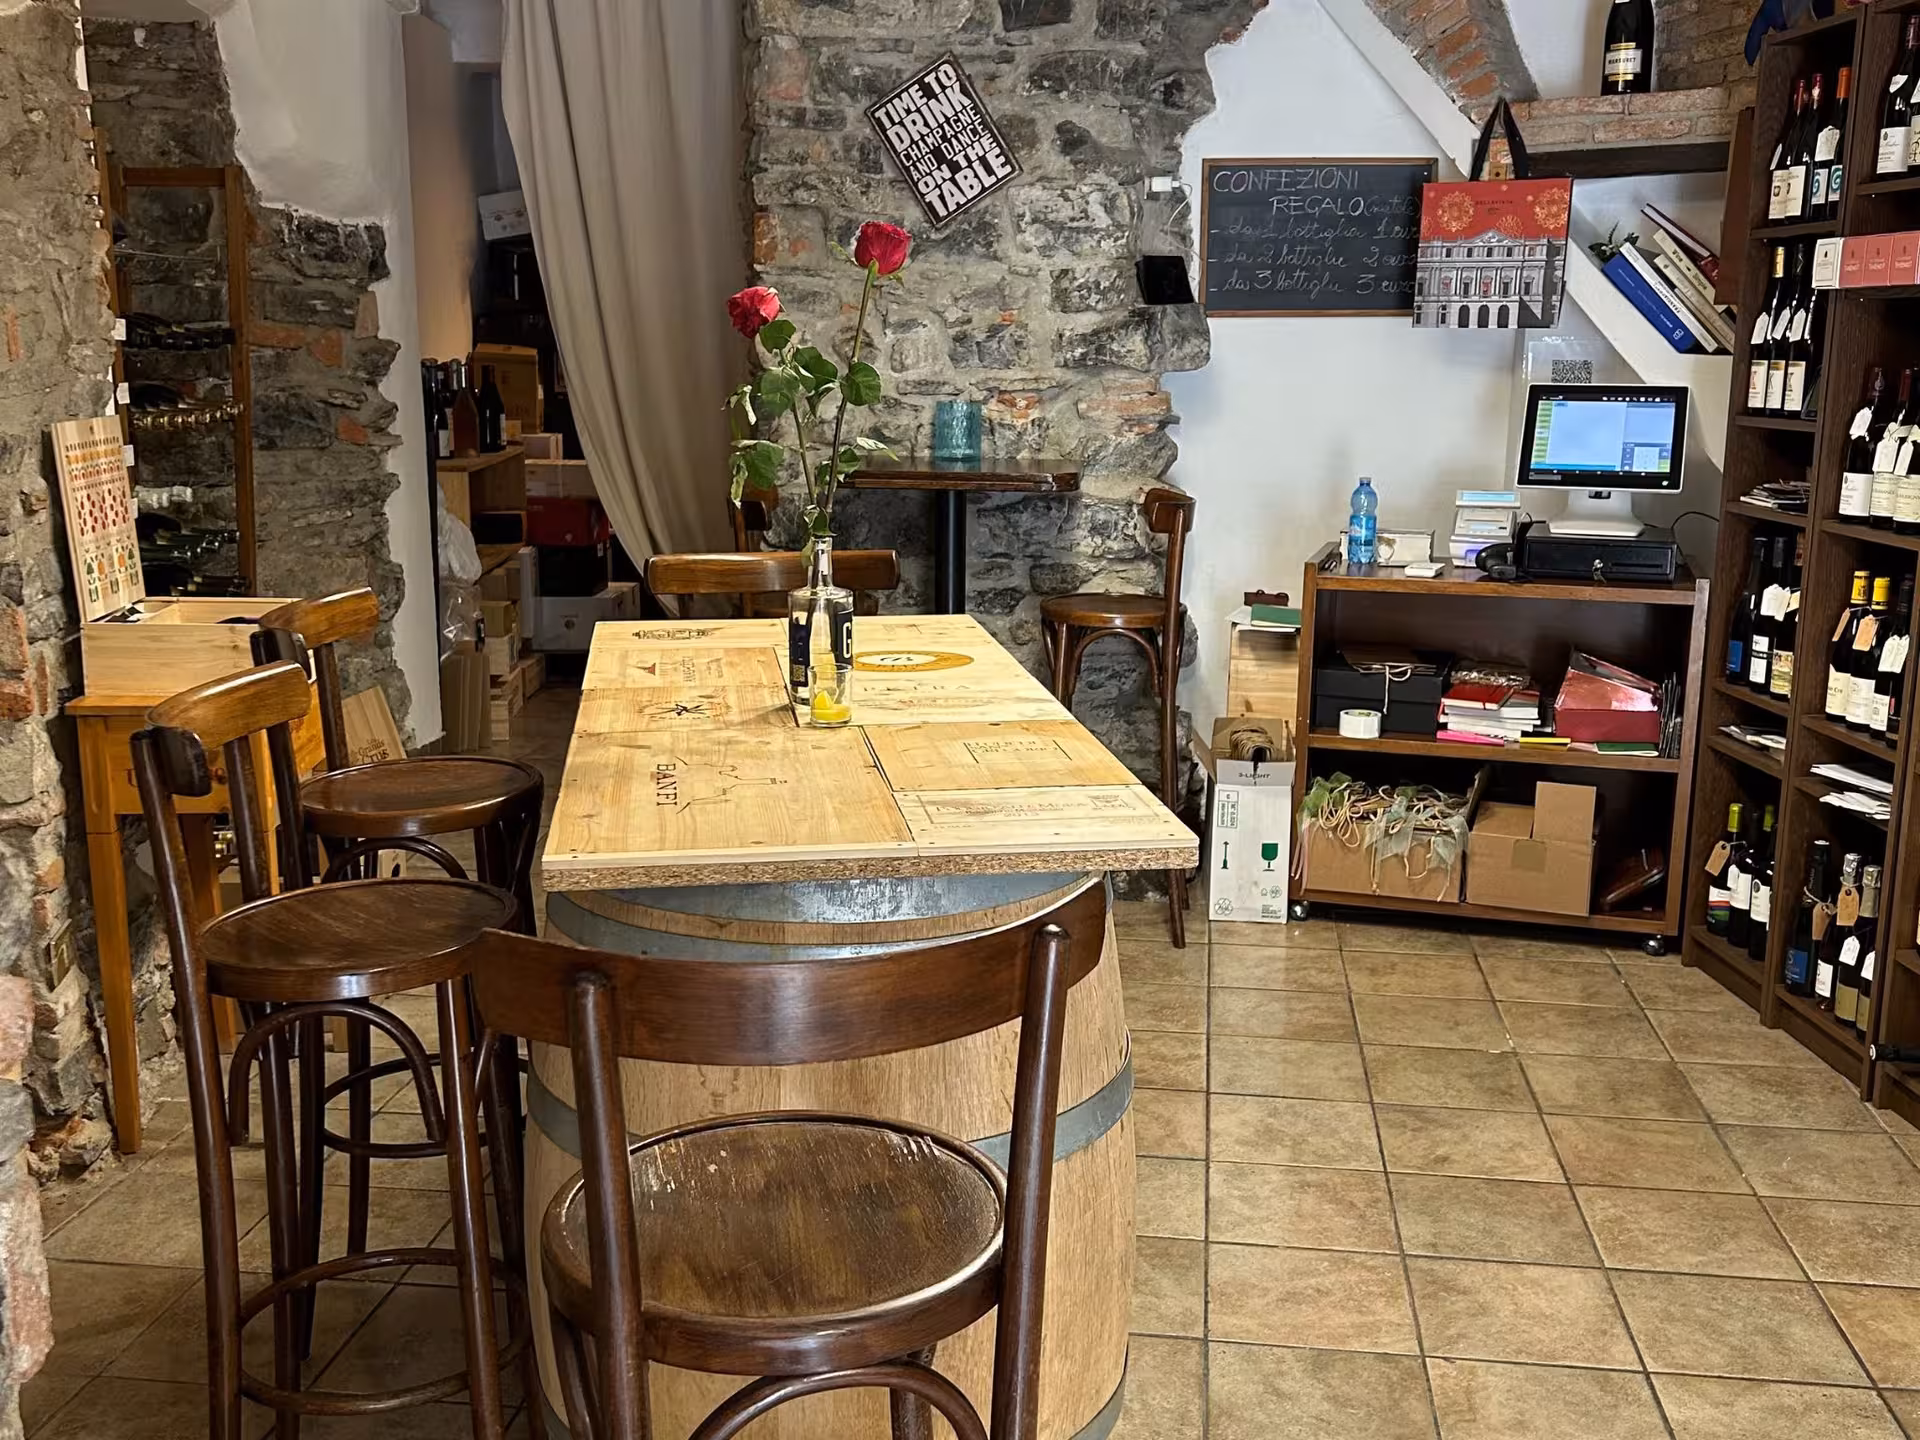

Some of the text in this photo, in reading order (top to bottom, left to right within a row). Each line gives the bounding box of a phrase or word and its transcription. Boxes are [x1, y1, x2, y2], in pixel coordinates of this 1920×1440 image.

[874, 63, 958, 130] TIME TO
[886, 81, 972, 153] DRINK
[900, 103, 982, 167] CHAMPAGNE
[910, 119, 989, 182] AND DANCE
[918, 133, 997, 195] ON THE
[924, 147, 1012, 218] TABLE
[1213, 167, 1359, 194] CONFEZIONI
[1269, 195, 1364, 218] REGALO
[1373, 217, 1388, 239] 1
[1224, 242, 1253, 264] da
[1363, 246, 1379, 267] 2
[1222, 268, 1249, 291] da
[1253, 270, 1273, 289] 3
[1356, 274, 1376, 295] 3
[656, 763, 678, 807] BANFI
